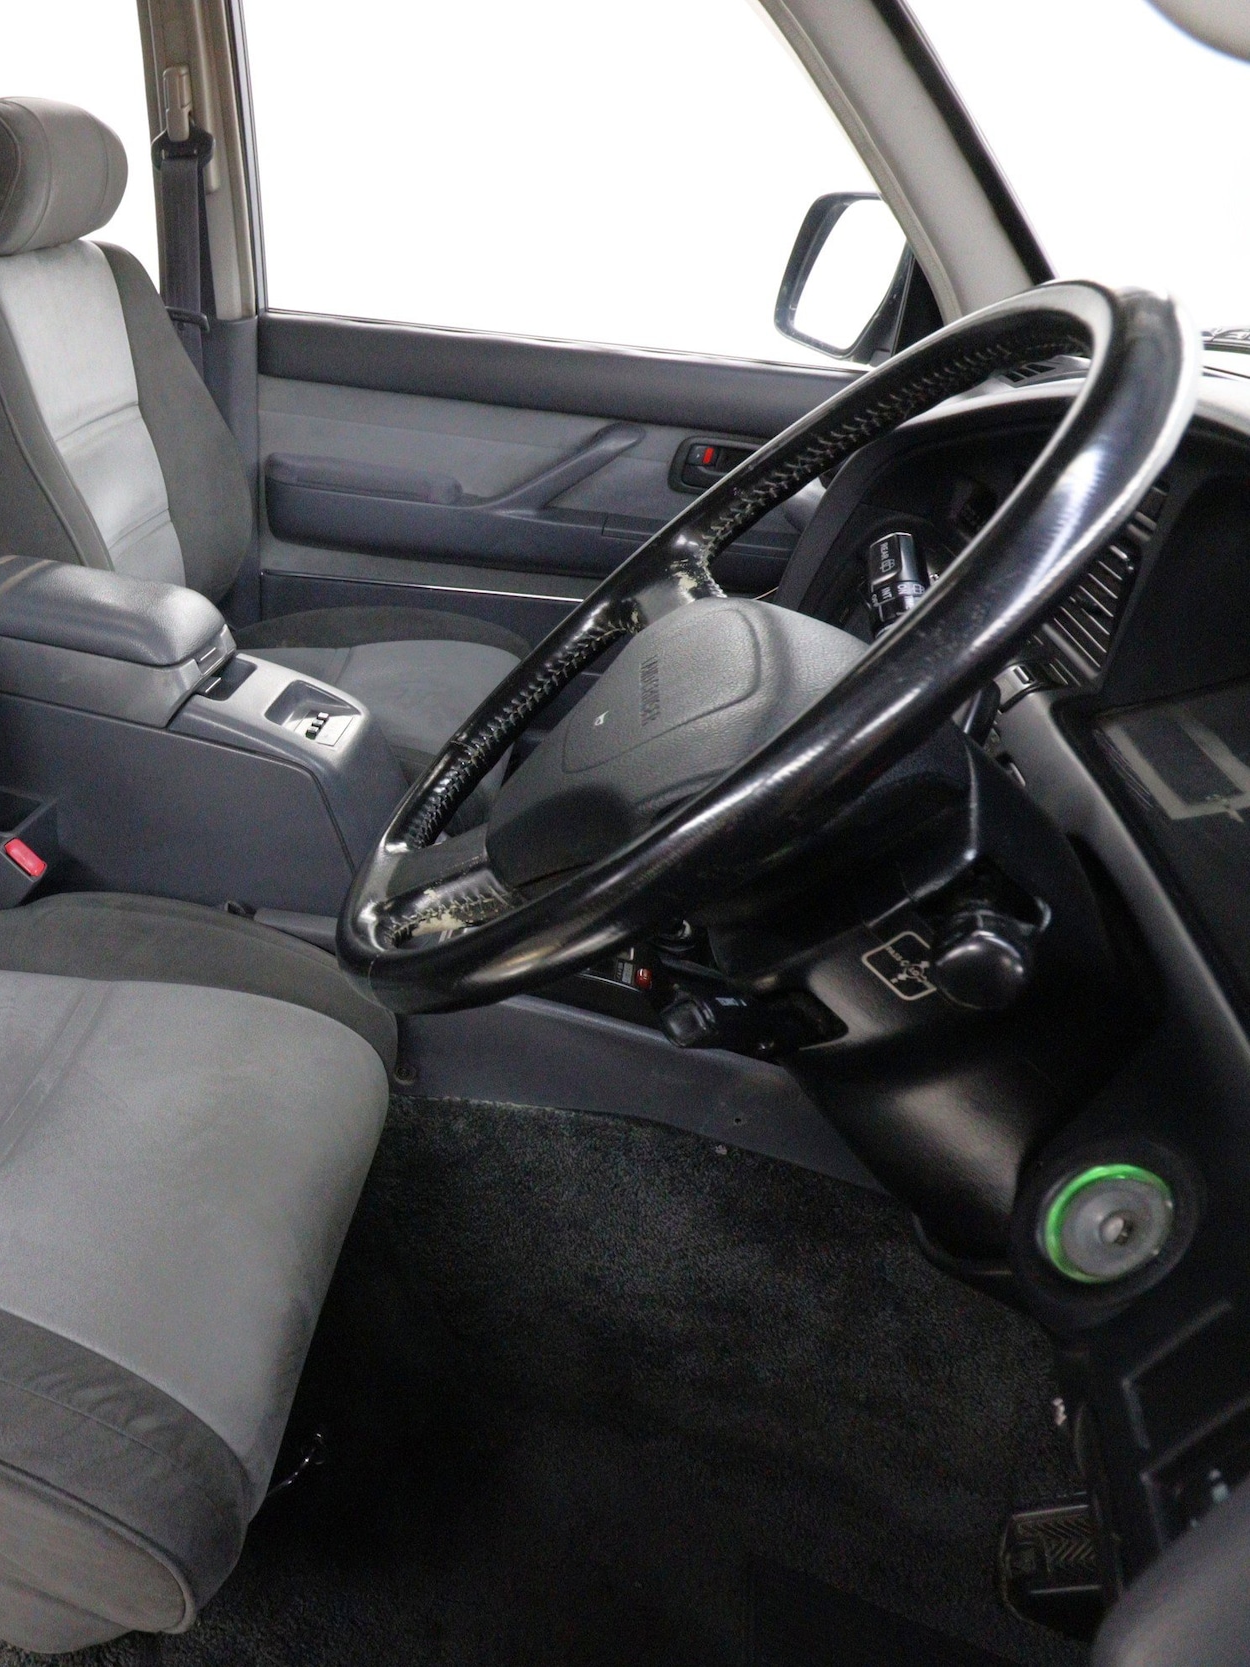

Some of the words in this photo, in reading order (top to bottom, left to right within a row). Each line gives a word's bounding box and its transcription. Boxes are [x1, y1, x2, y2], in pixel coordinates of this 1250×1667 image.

[880, 541, 889, 560] REAR
[882, 586, 892, 600] INT
[897, 584, 907, 595] ON
